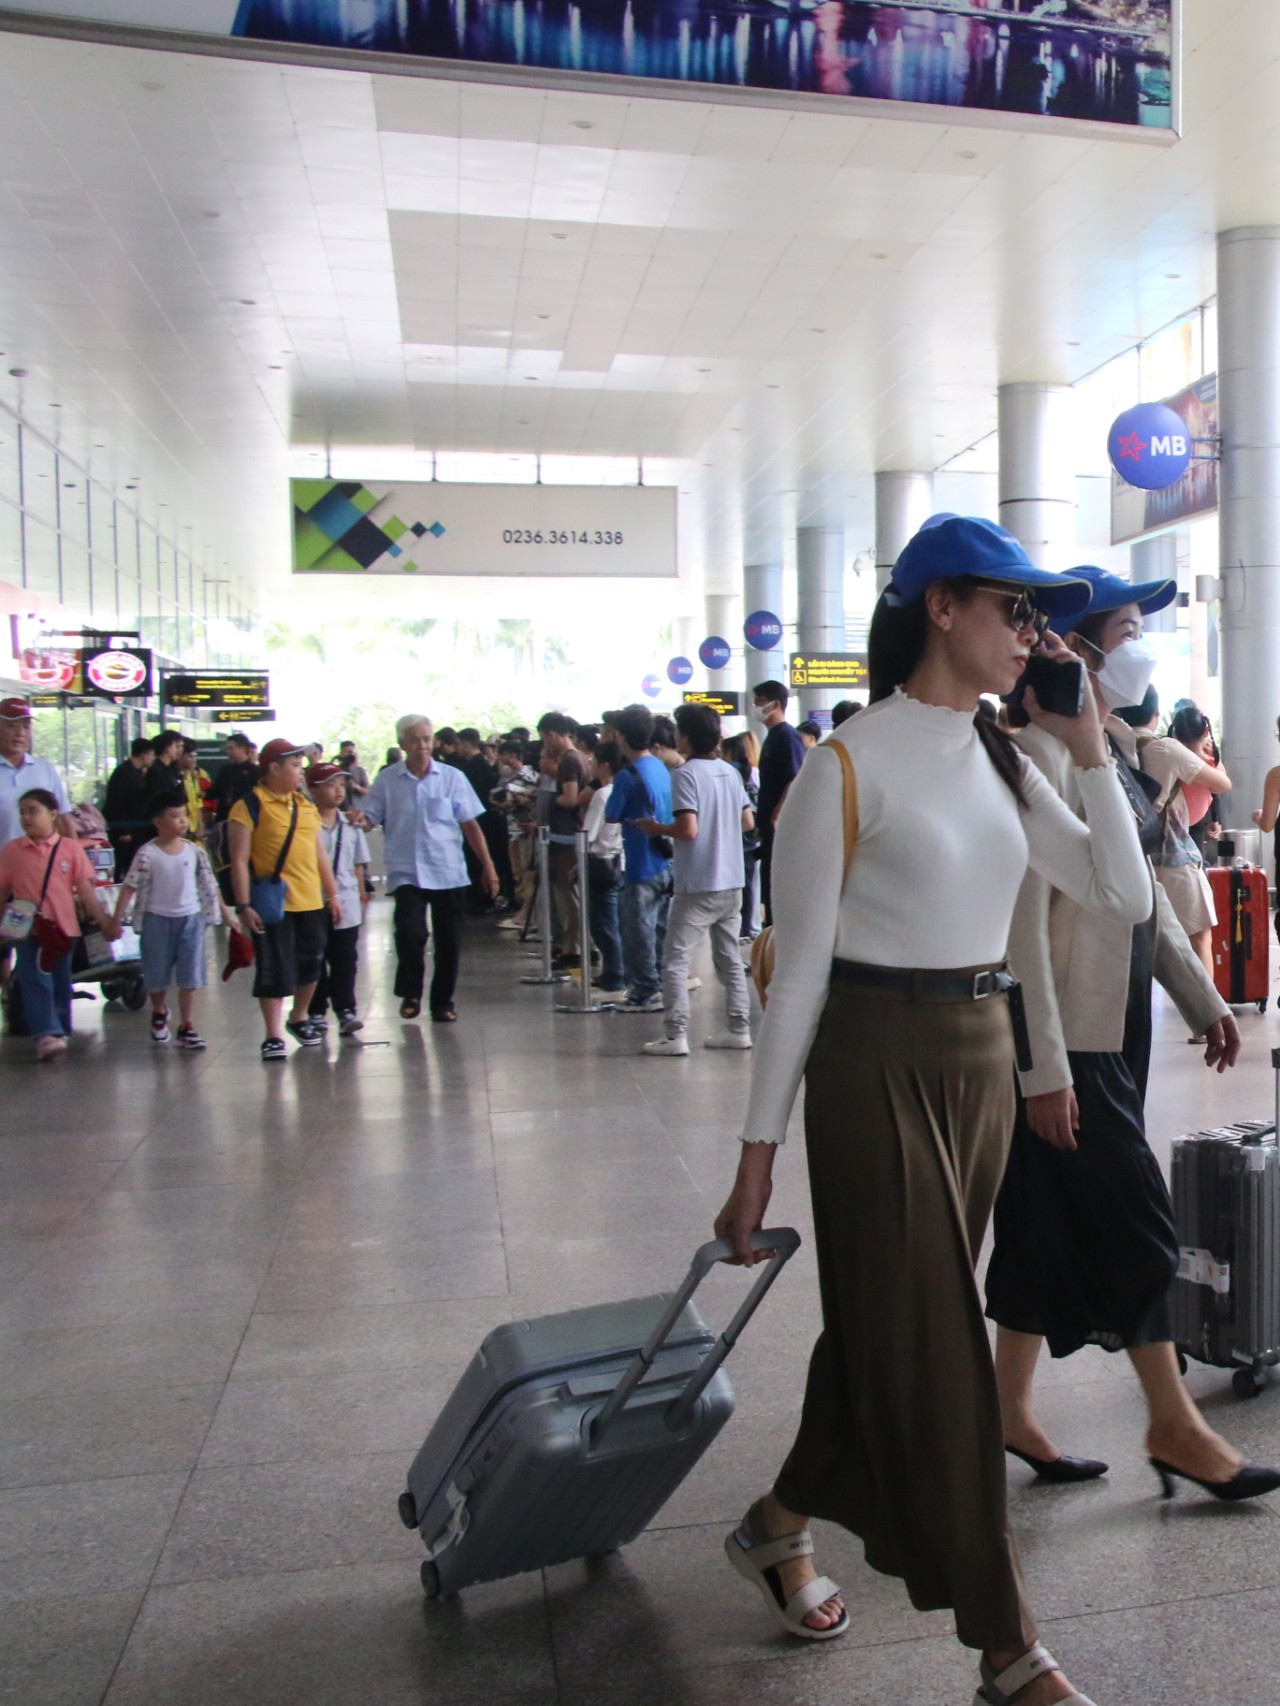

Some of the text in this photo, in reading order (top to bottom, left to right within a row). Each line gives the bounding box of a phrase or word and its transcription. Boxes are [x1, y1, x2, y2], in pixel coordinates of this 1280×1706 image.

[1150, 435, 1186, 456] MB
[502, 529, 623, 545] 0236.3614.338
[761, 624, 780, 635] MB
[713, 648, 729, 657] MB
